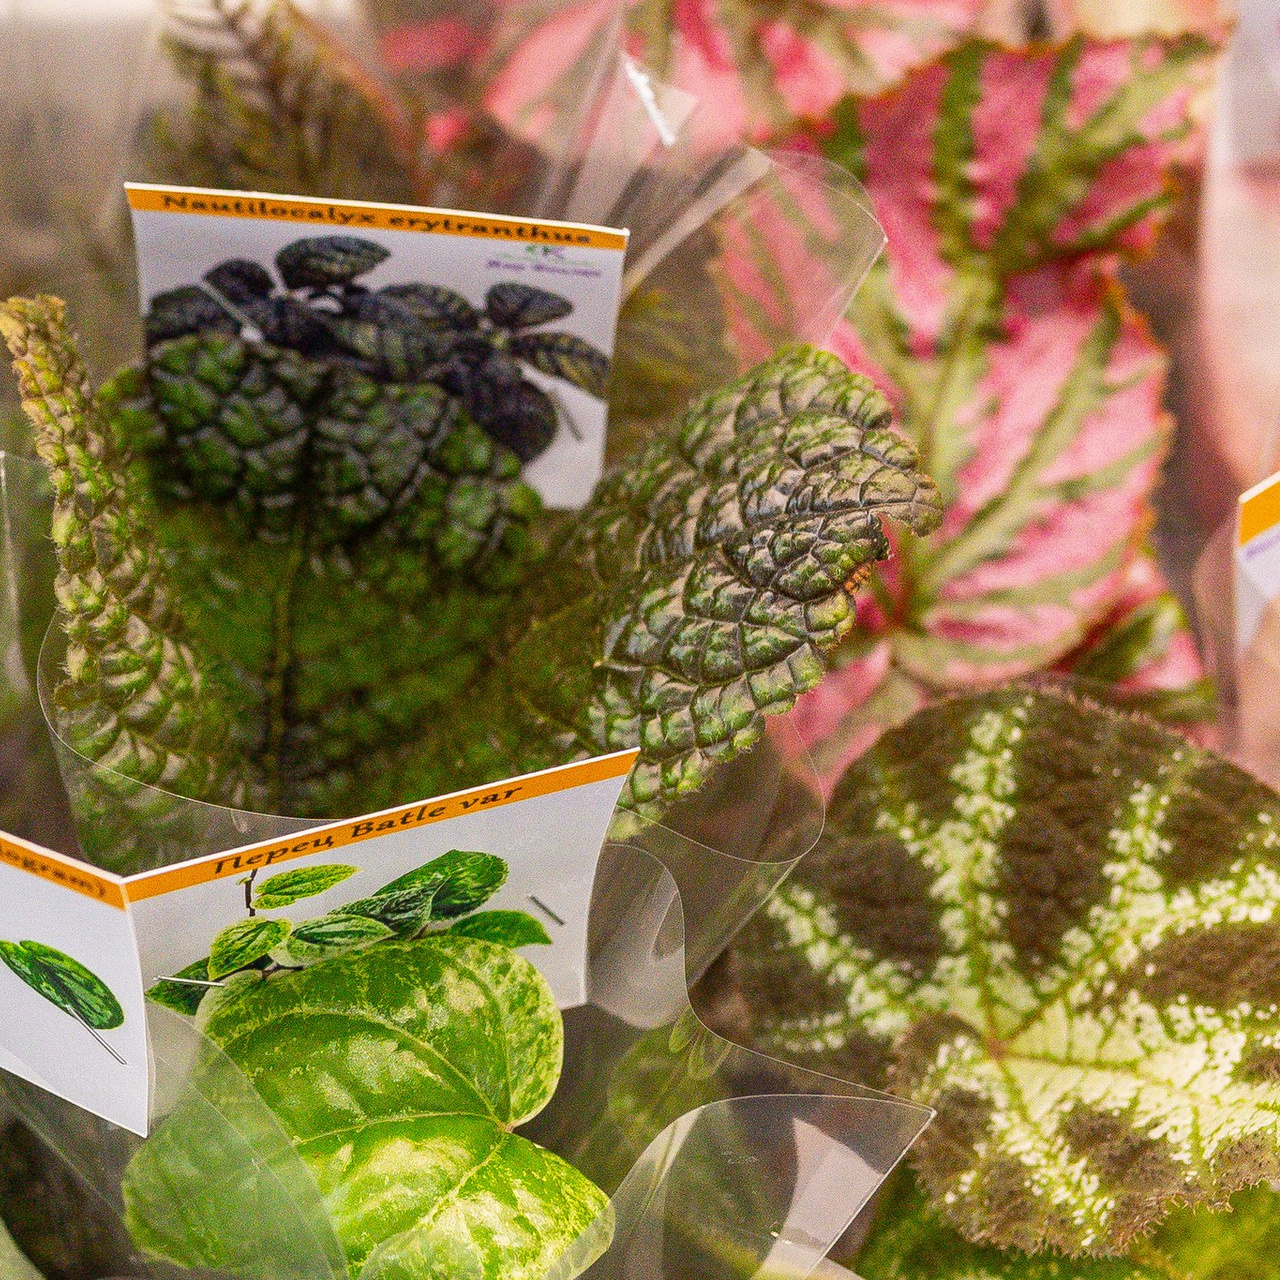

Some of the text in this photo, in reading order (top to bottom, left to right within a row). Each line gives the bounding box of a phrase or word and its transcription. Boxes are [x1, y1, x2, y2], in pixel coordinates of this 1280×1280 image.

[163, 194, 375, 224] Nautilocalyx
[215, 786, 523, 874] Перец Batle var
